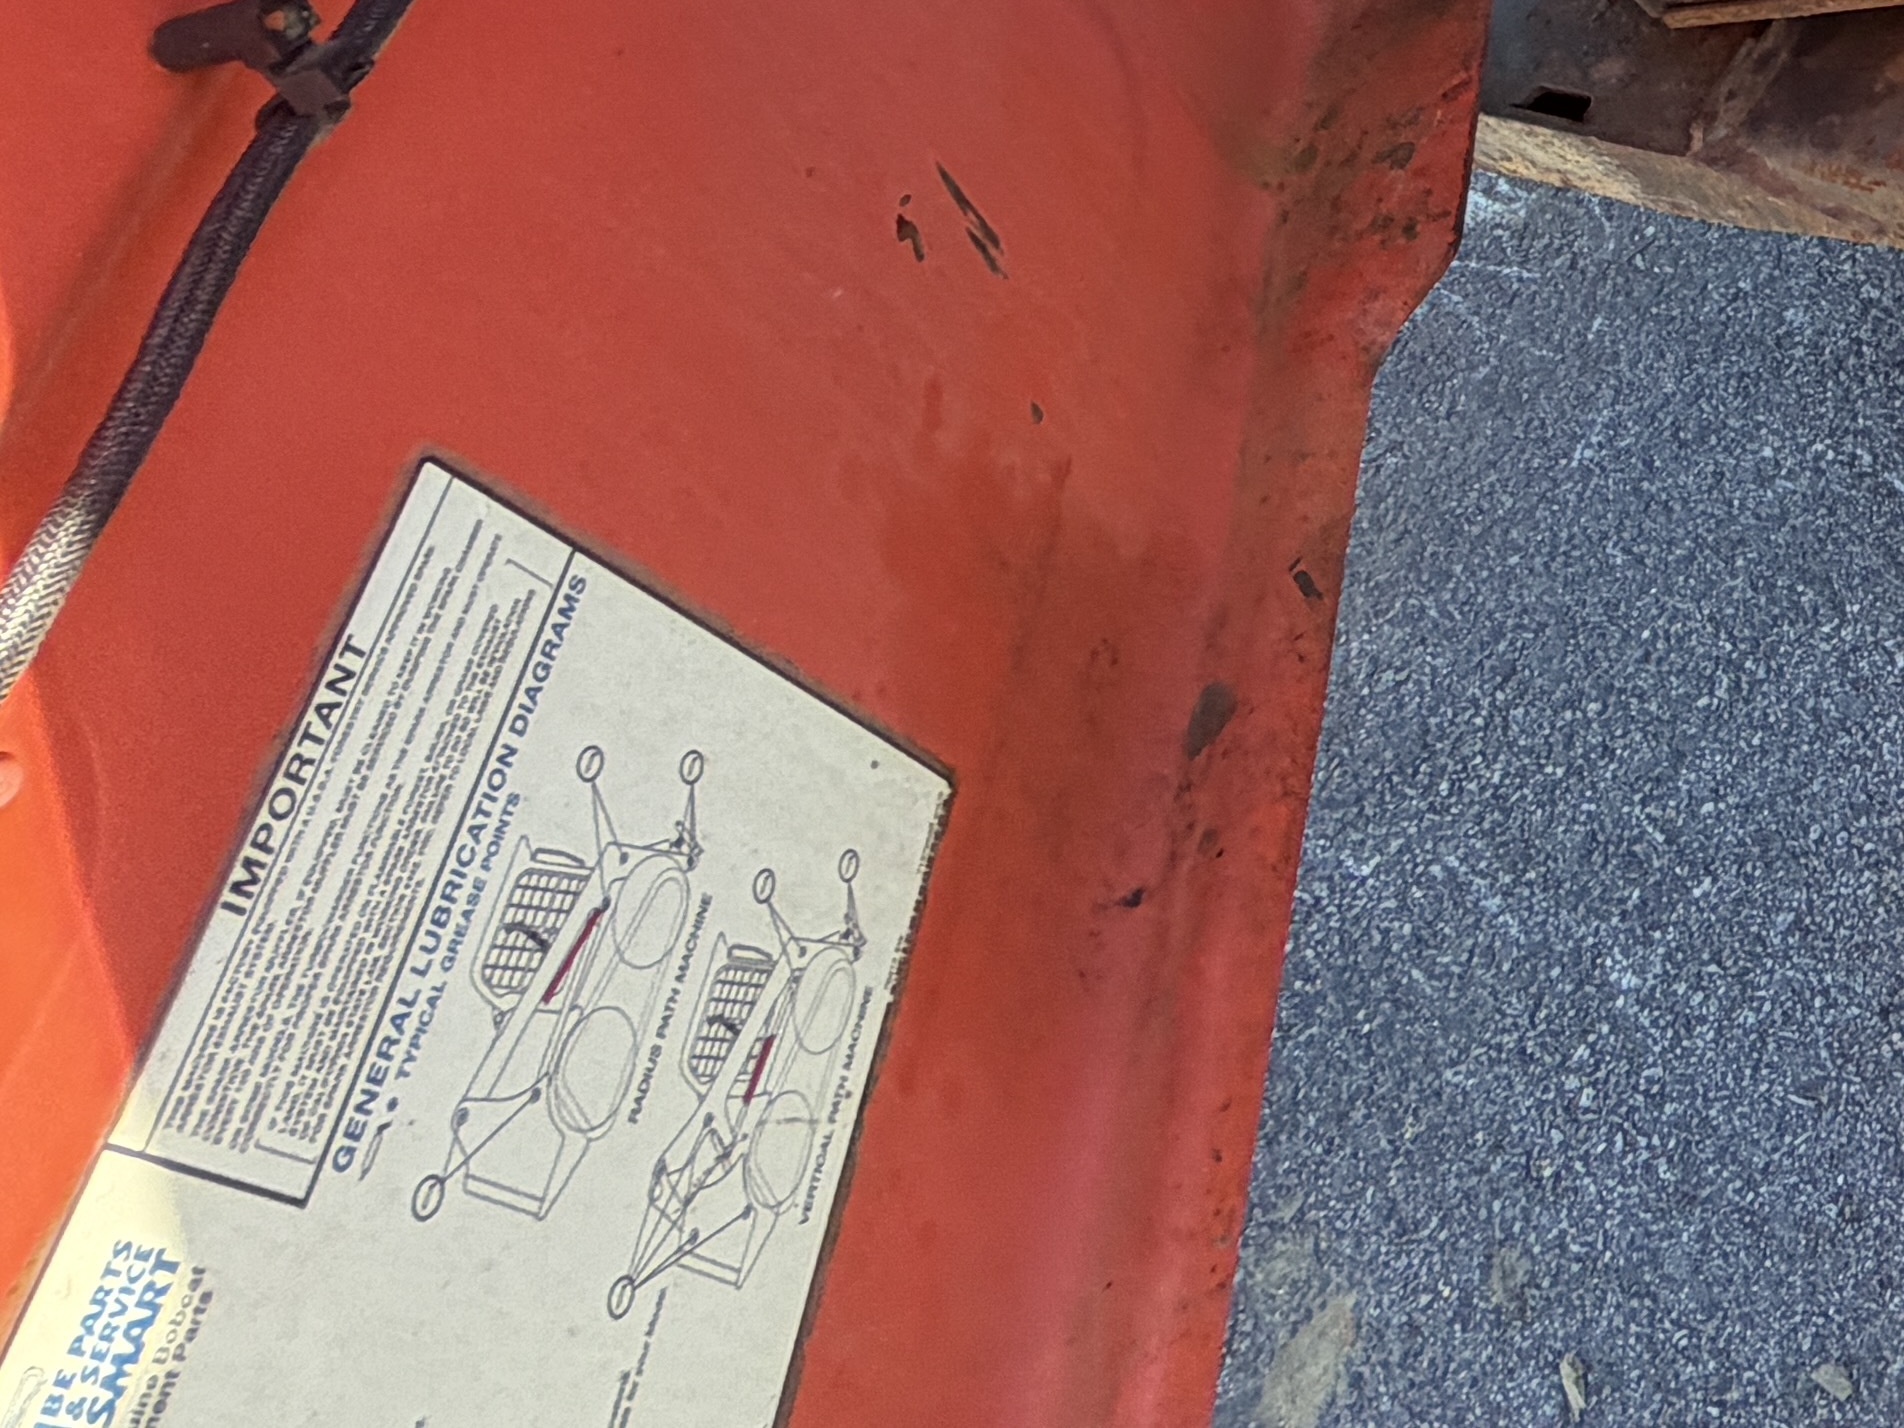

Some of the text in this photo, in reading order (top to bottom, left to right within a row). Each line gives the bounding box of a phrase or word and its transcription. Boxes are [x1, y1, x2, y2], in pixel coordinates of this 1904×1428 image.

[218, 631, 371, 920] IMPORTANT
[328, 571, 590, 1177] GENERAL LUBRICATION DIAGRAMS
[392, 788, 523, 1085] TYPICAL GREASE POINTS
[625, 890, 714, 1126] RADIUS PATH MACHINE
[796, 983, 876, 1227] VERTICAL PATH MACHINE
[38, 1236, 136, 1418] BE PARTS
[63, 1242, 156, 1420] & SERVICE
[81, 1245, 184, 1428] SMART
[150, 1261, 208, 1365] Bobcat
